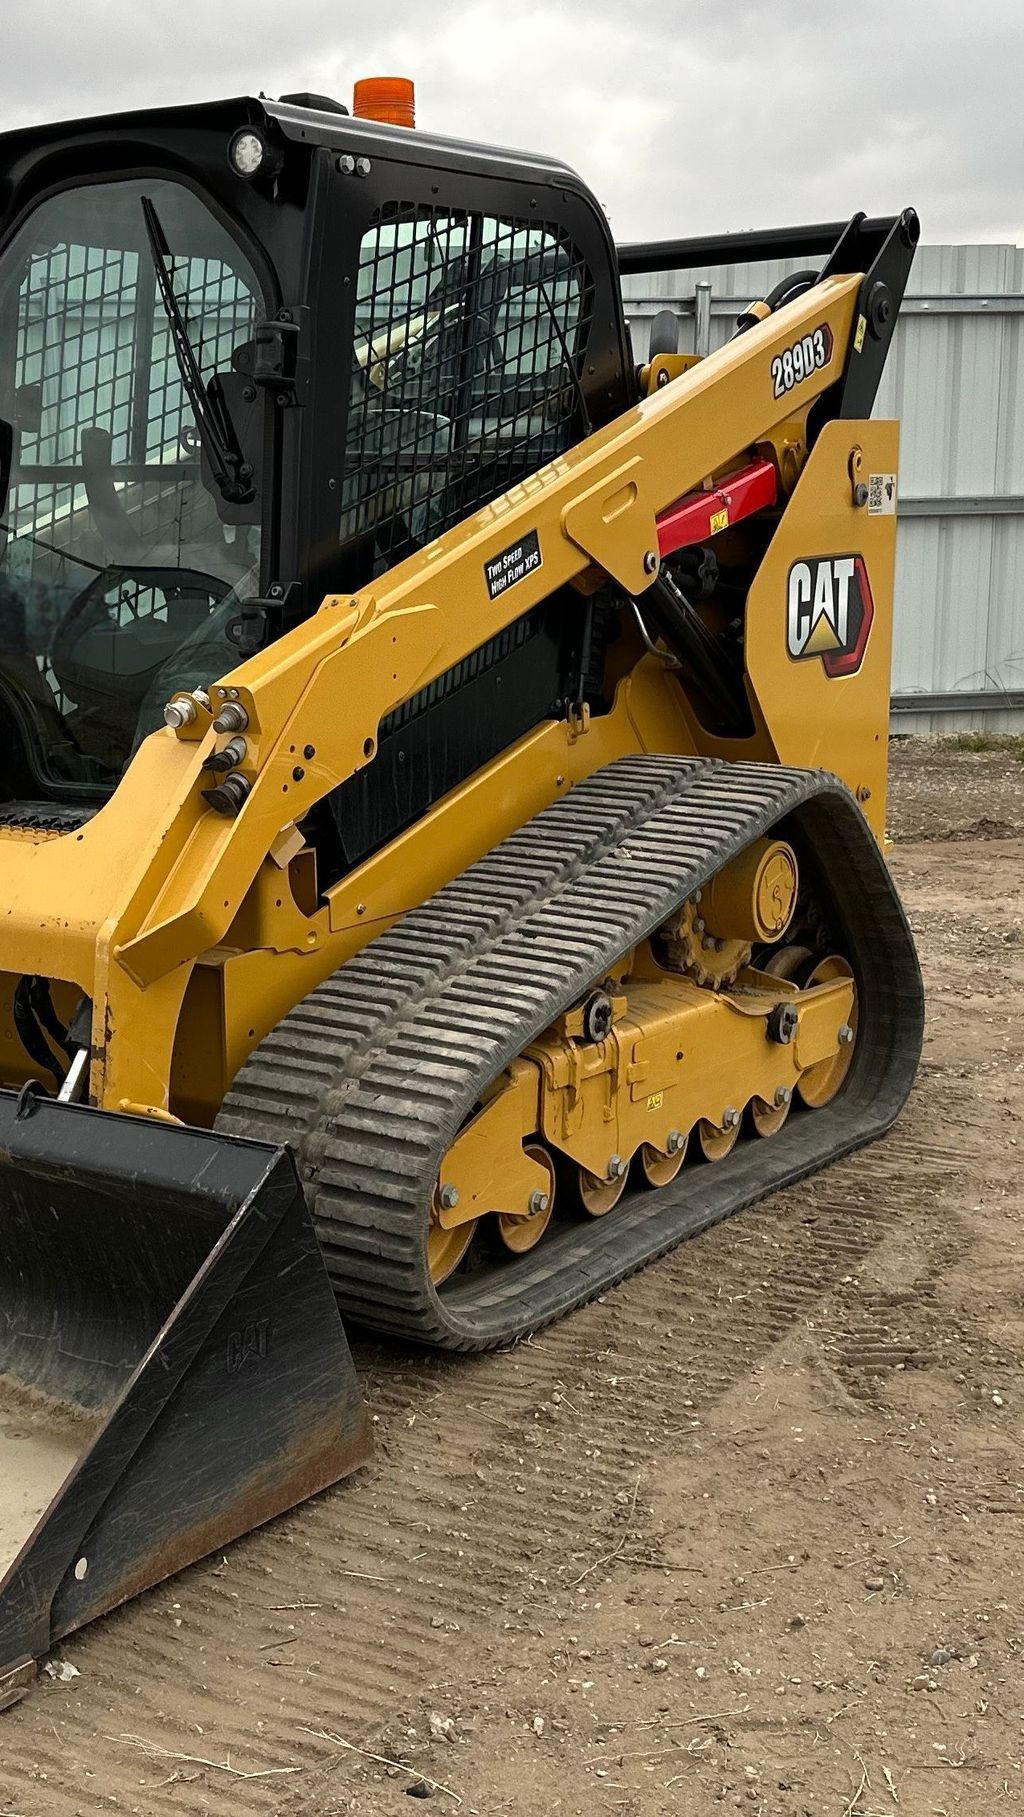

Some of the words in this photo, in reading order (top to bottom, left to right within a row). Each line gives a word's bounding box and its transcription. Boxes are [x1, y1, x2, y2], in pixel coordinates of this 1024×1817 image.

[772, 329, 825, 397] 289D3
[524, 551, 539, 571] XPS
[788, 558, 855, 656] CAT
